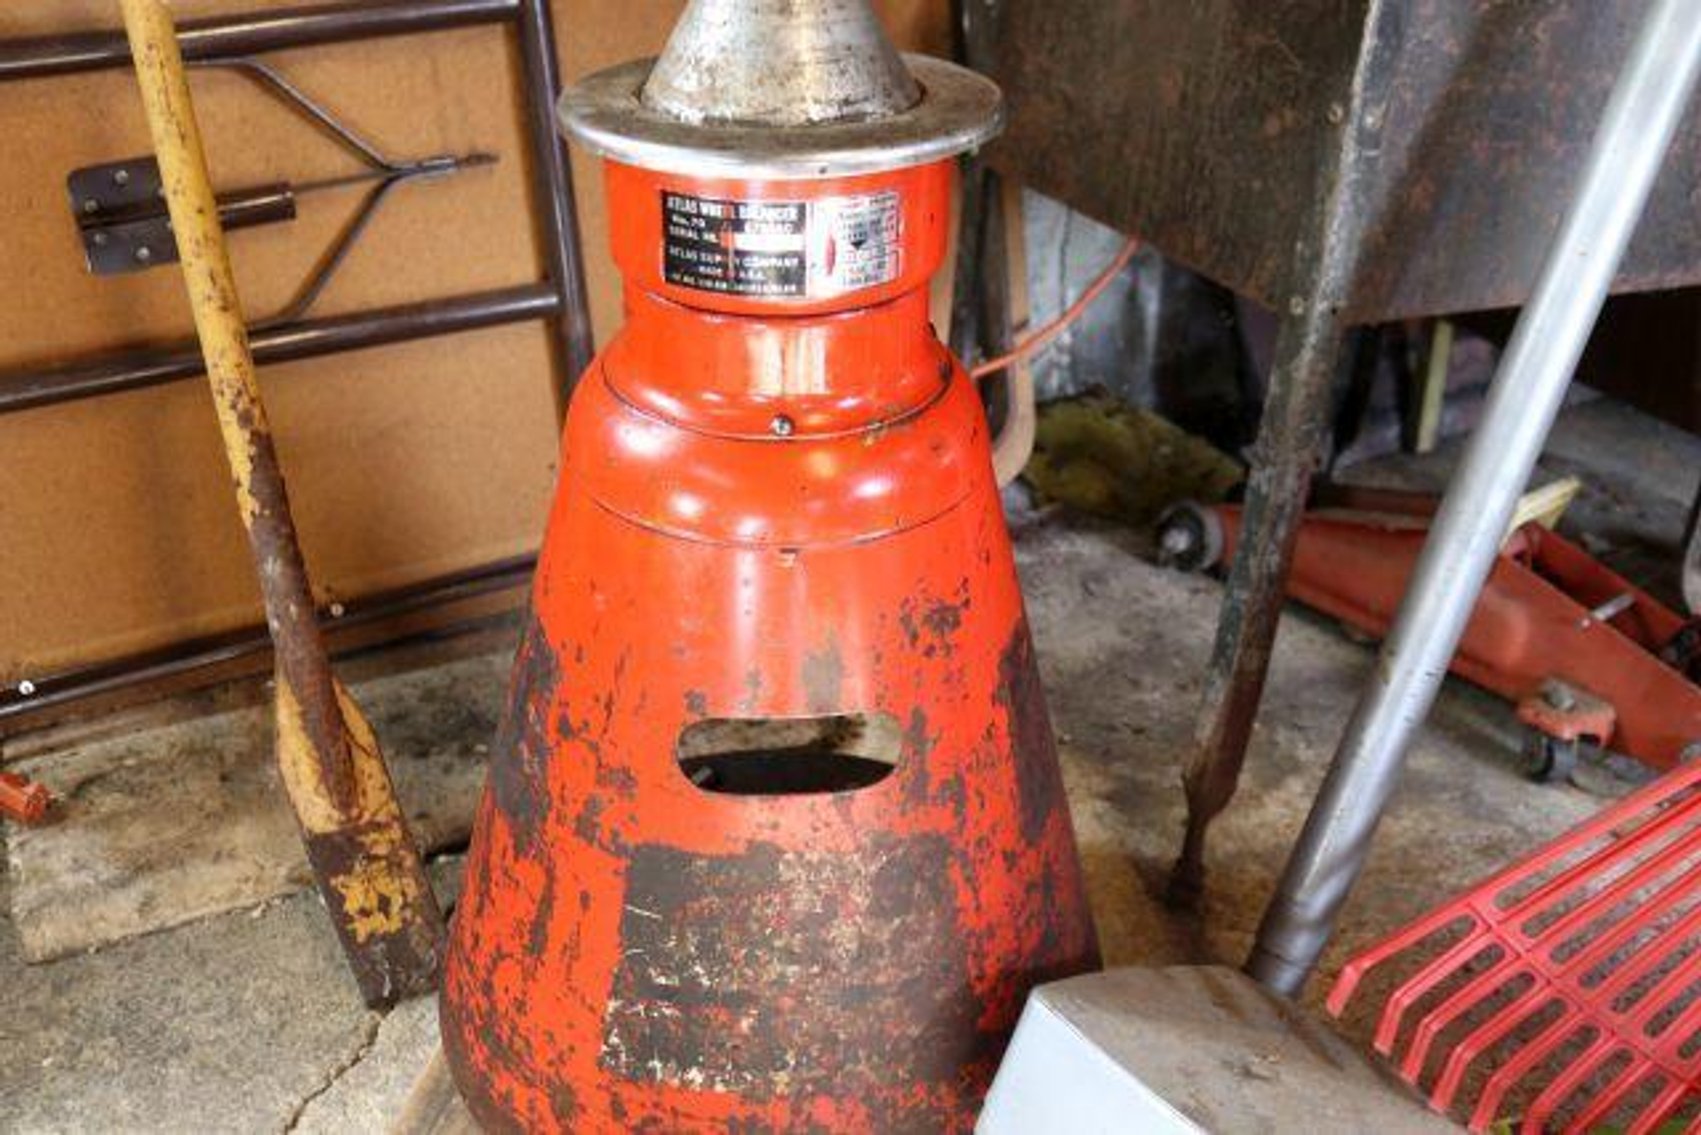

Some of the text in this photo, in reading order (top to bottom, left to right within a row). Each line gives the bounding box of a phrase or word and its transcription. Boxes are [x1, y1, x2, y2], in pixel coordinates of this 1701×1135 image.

[667, 196, 697, 213] ATLAS
[699, 201, 735, 219] WHEL
[669, 226, 699, 240] SERIAL
[669, 245, 697, 260] ATLAS
[743, 257, 799, 268] COMPANY
